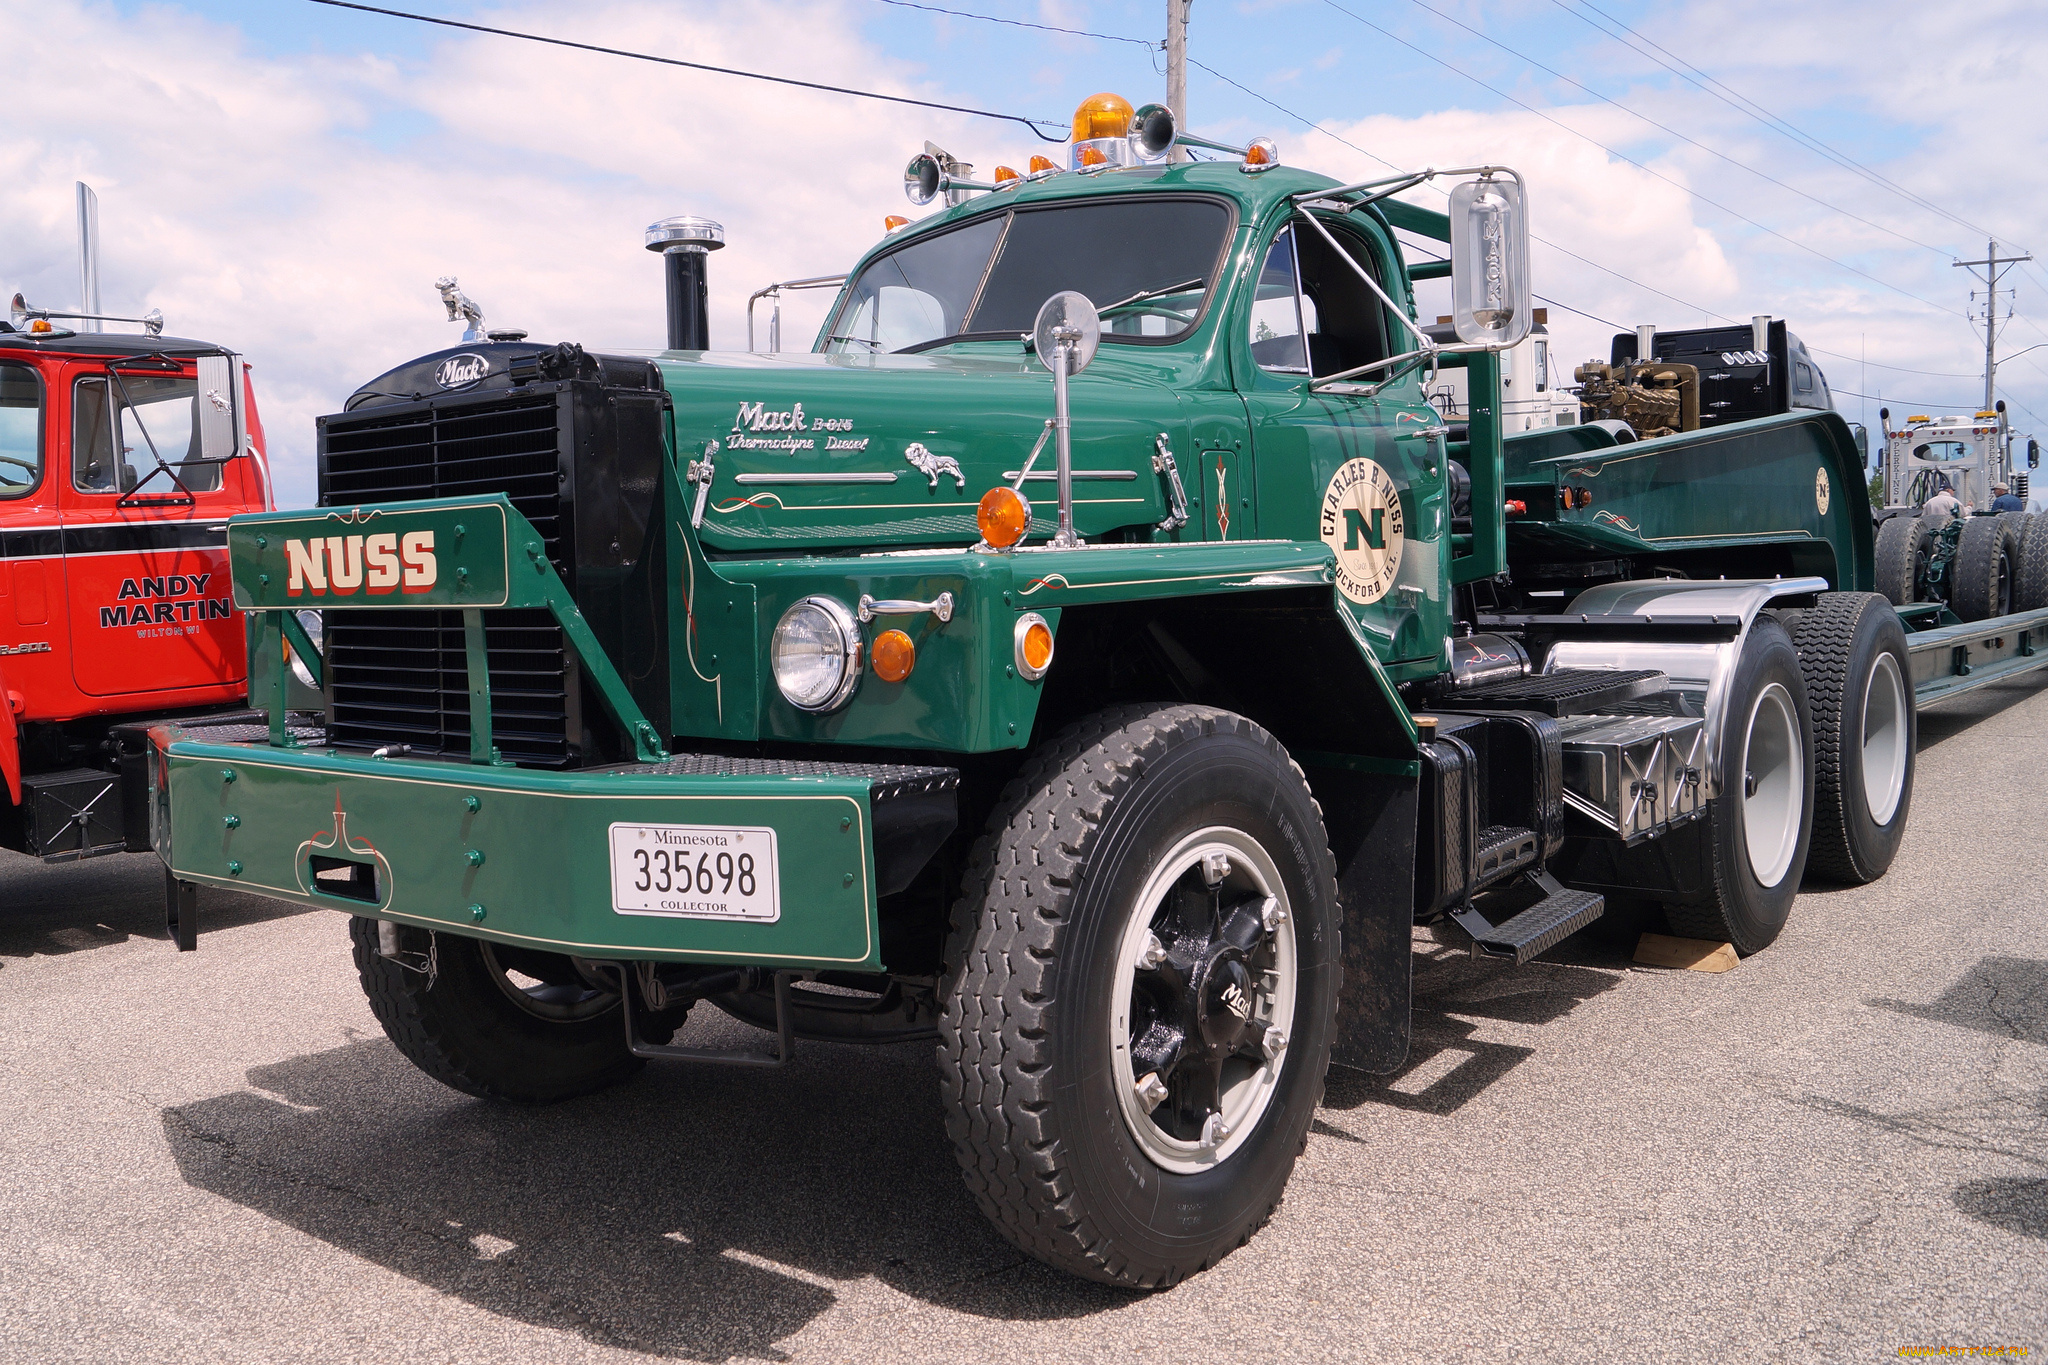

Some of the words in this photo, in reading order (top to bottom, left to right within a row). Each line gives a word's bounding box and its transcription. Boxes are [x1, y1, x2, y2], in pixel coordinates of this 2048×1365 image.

[1483, 221, 1501, 302] MACK
[440, 358, 481, 384] Mack
[732, 401, 807, 431] Mack
[726, 434, 814, 455] Thermodyne
[824, 436, 869, 450] Diesel
[1323, 462, 1365, 536] CHARLES
[1371, 466, 1379, 487] B.
[1382, 481, 1402, 534] NUSS
[1819, 483, 1826, 498] N
[1343, 508, 1386, 551] N
[284, 531, 437, 596] NUSS
[1384, 551, 1398, 581] ILL.
[118, 573, 211, 599] ANDY
[99, 598, 231, 628] MARTIN
[137, 626, 183, 638] WILTON,
[186, 625, 200, 635] WI
[654, 830, 728, 846] Minnesota
[634, 849, 756, 896] 335698
[661, 901, 728, 912] COLLECTOR
